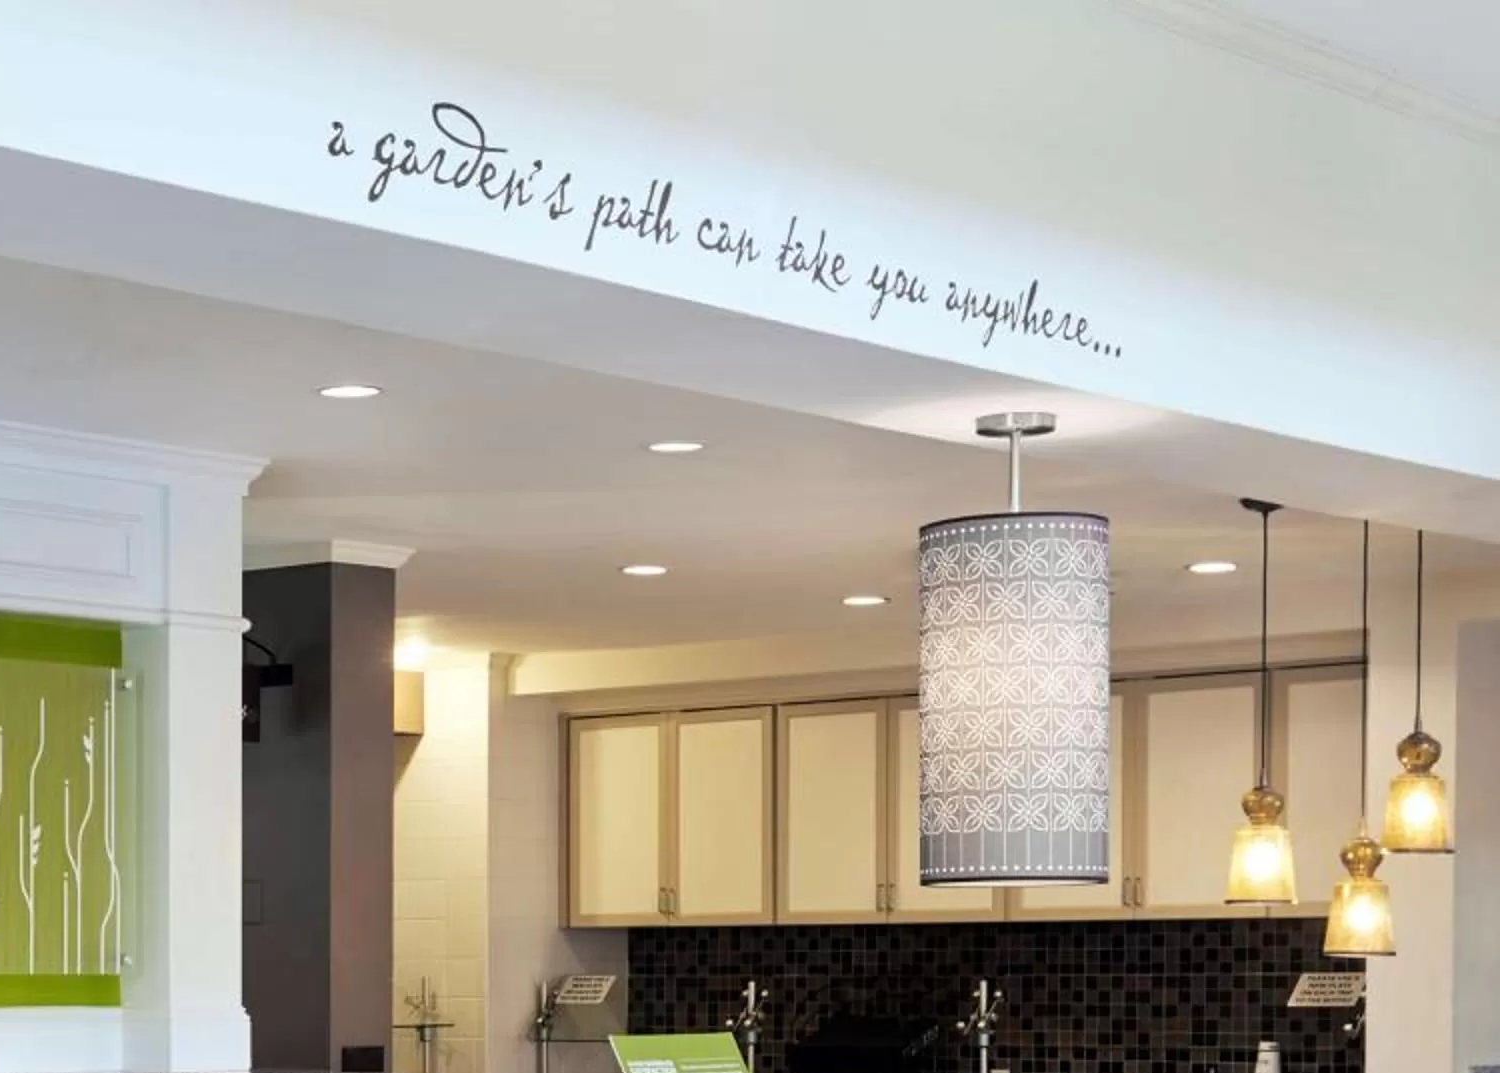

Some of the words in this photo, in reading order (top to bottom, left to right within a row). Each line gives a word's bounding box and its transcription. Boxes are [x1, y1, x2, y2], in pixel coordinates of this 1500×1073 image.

[327, 120, 354, 157] a
[368, 101, 574, 221] garden's
[584, 179, 679, 251] path
[697, 217, 760, 267] can
[776, 215, 851, 293] take
[867, 263, 929, 321] you
[944, 279, 1121, 359] anywhere...
